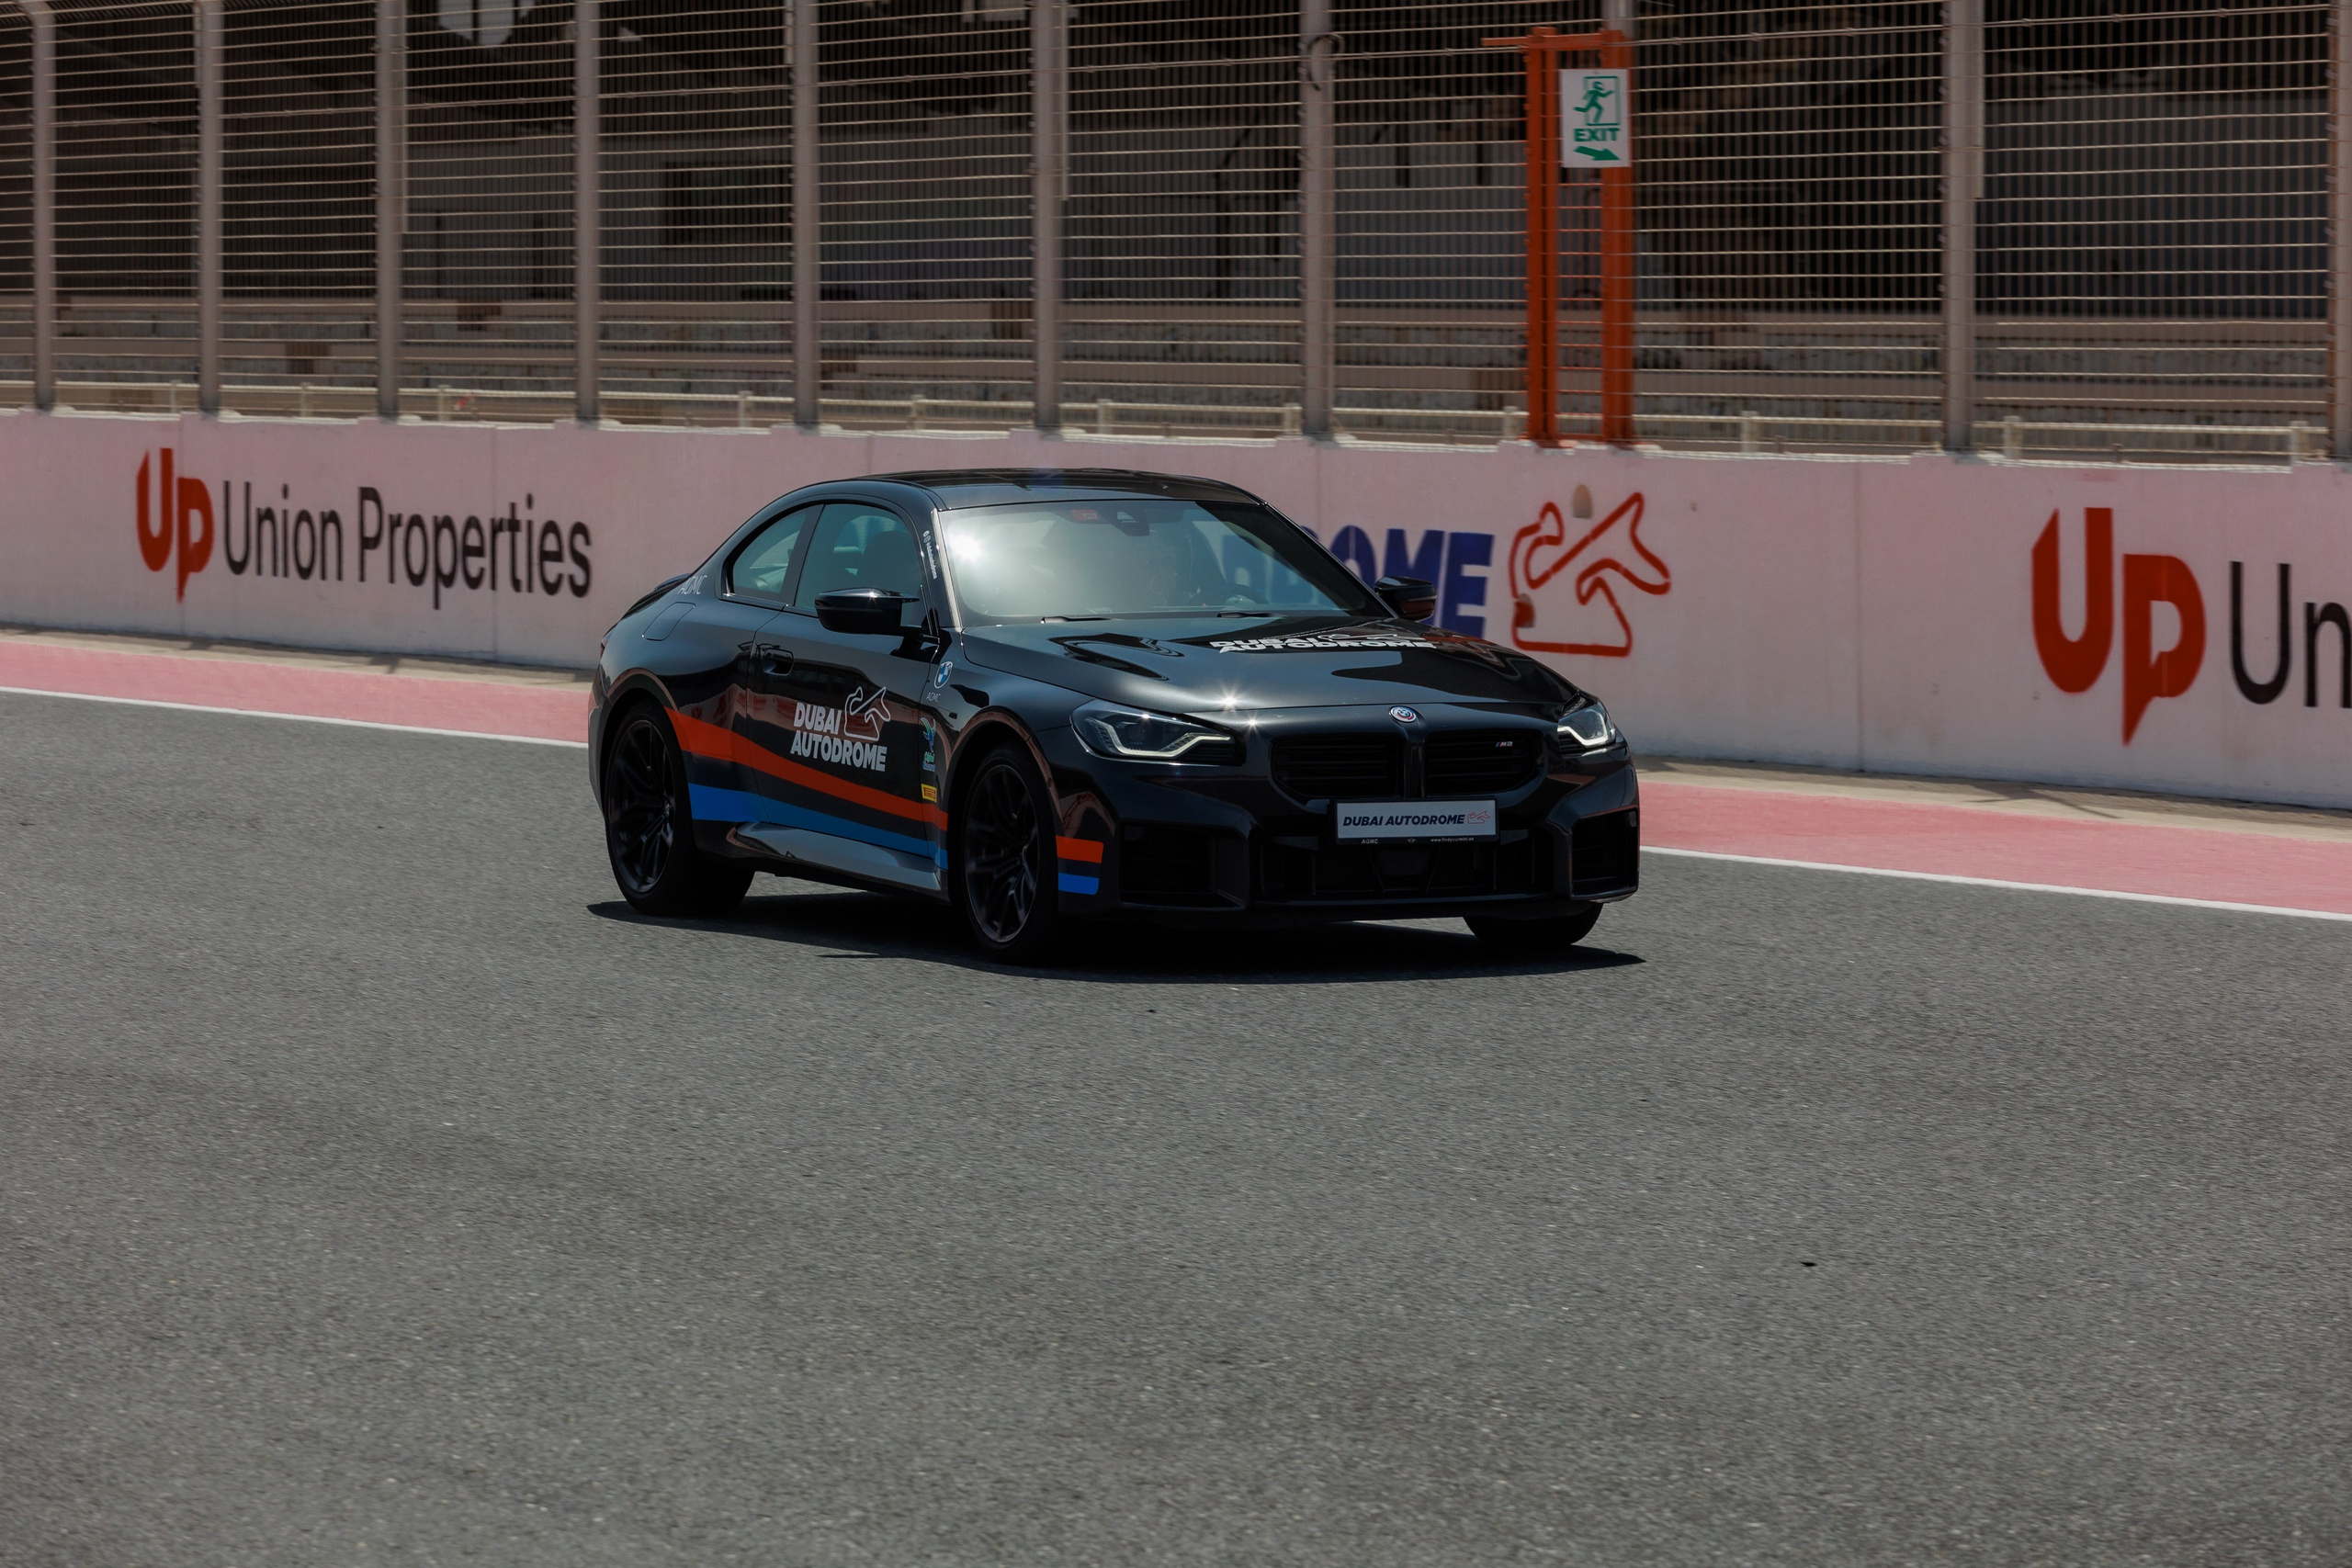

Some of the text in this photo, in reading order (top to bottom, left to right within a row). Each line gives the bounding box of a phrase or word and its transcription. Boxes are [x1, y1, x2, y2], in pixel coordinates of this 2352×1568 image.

[1574, 128, 1621, 141] EXIT
[222, 480, 593, 611] Union Properties
[677, 575, 707, 594] AGMC
[1209, 637, 1320, 647] DUBAI
[2229, 560, 2352, 709] Un
[1219, 640, 1437, 653] AUTODROME
[794, 702, 842, 735] DUBAI
[790, 729, 888, 772] AUTODROME
[1343, 814, 1465, 826] DUBAI AUTODROME
